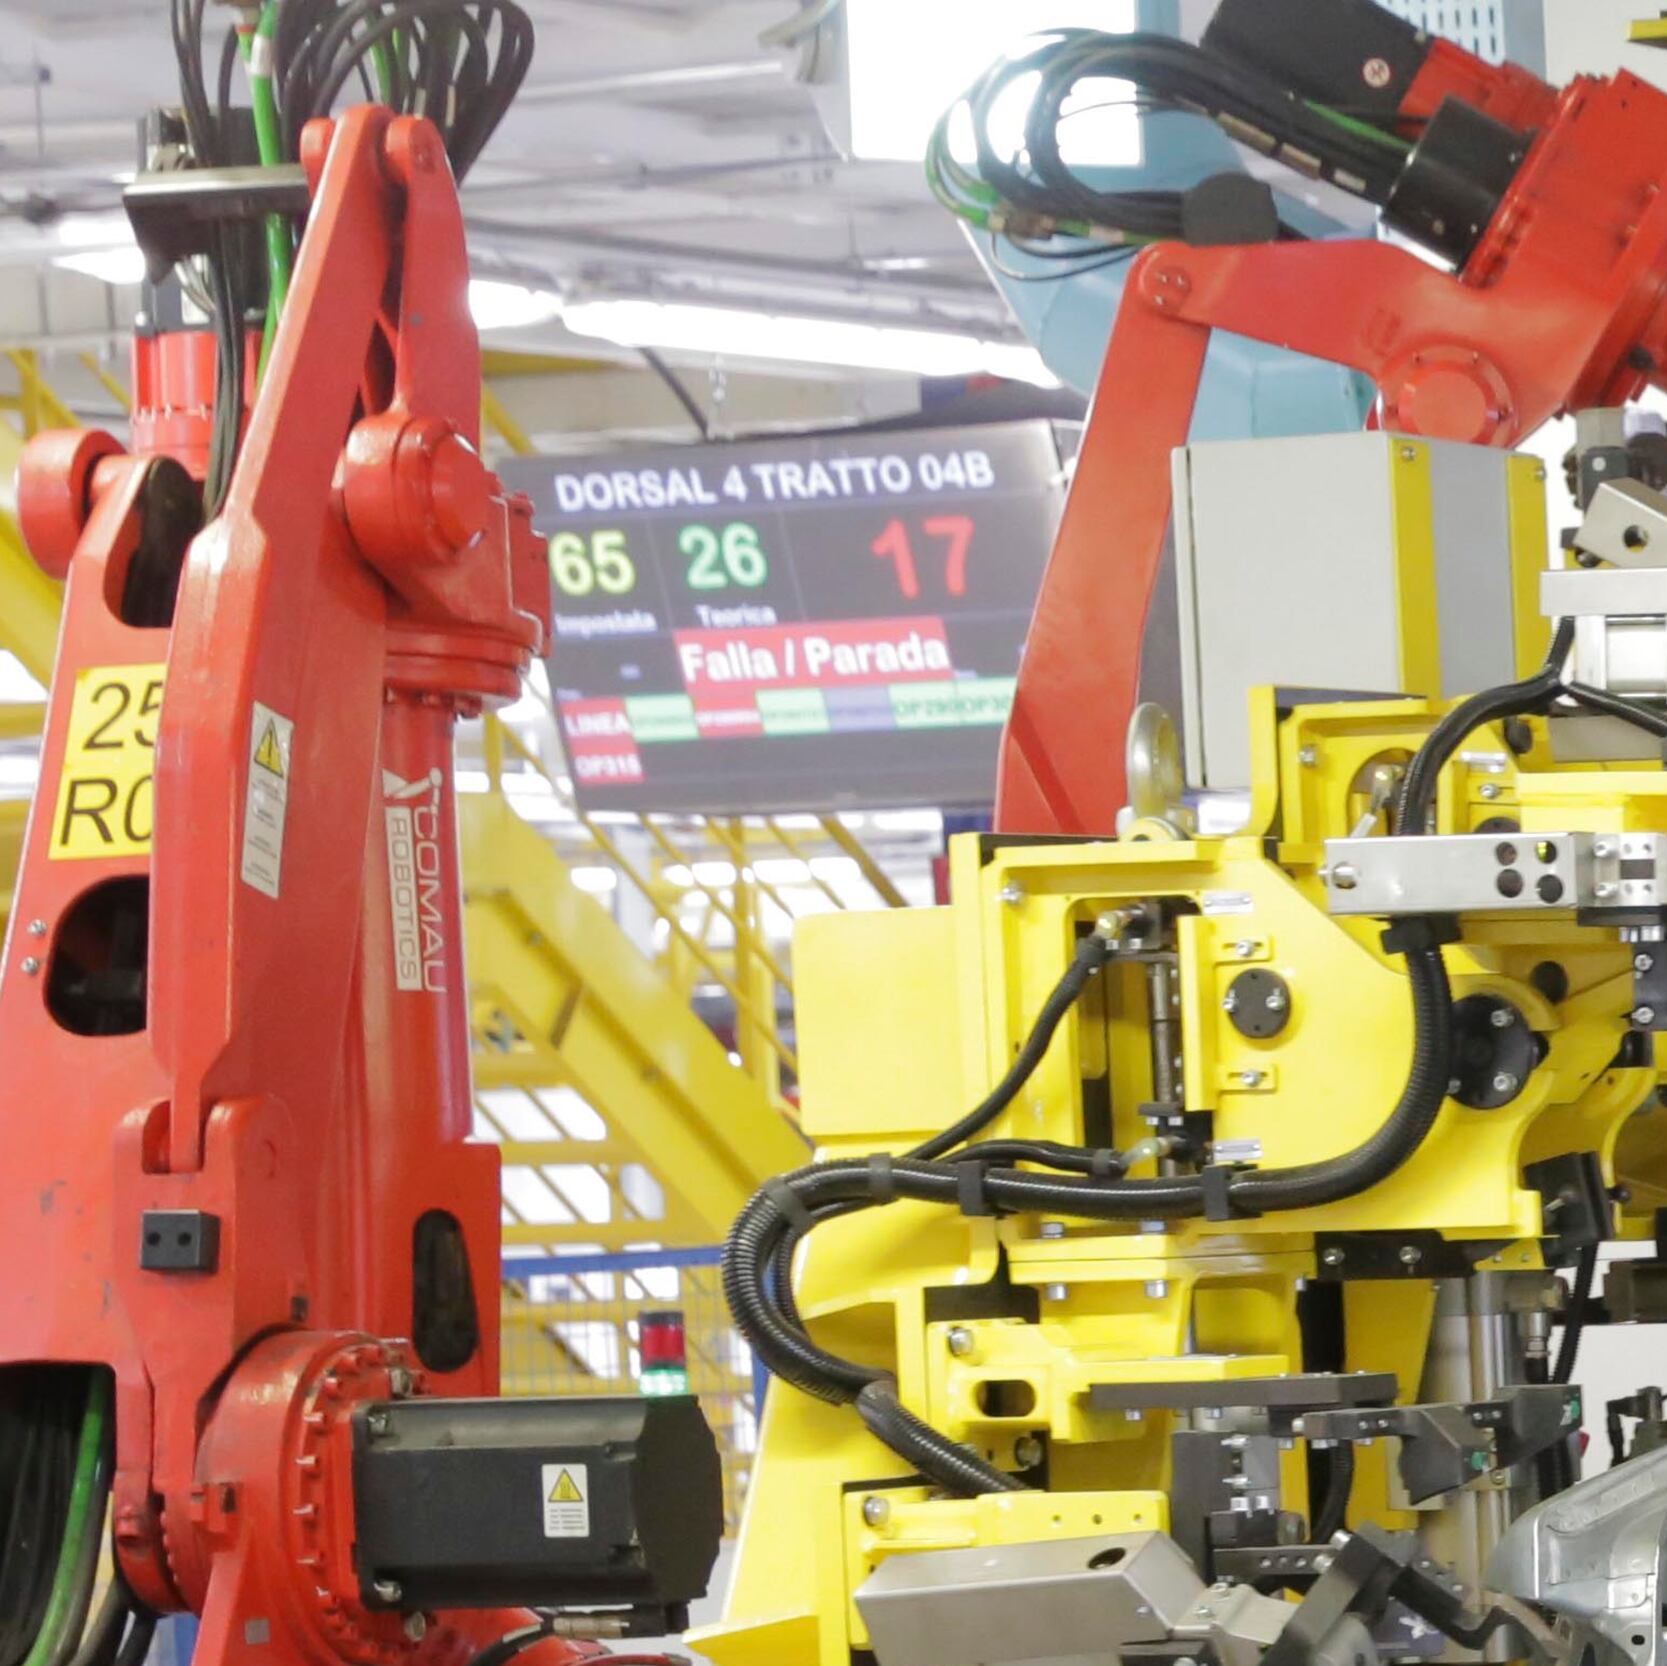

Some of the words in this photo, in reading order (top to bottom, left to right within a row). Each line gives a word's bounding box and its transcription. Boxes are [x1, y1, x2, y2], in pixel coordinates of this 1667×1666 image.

[555, 466, 718, 512] DORSAL
[722, 464, 748, 502] 4
[751, 455, 912, 500] TRATTO
[918, 450, 996, 491] 04B
[550, 531, 636, 595] 65
[680, 522, 768, 588] 26
[870, 515, 975, 599] 17
[680, 640, 778, 682] Falla
[803, 630, 950, 676] Parada
[563, 711, 632, 735] LINEA
[391, 817, 417, 980] ROBOTICS
[413, 804, 447, 993] COMAU
